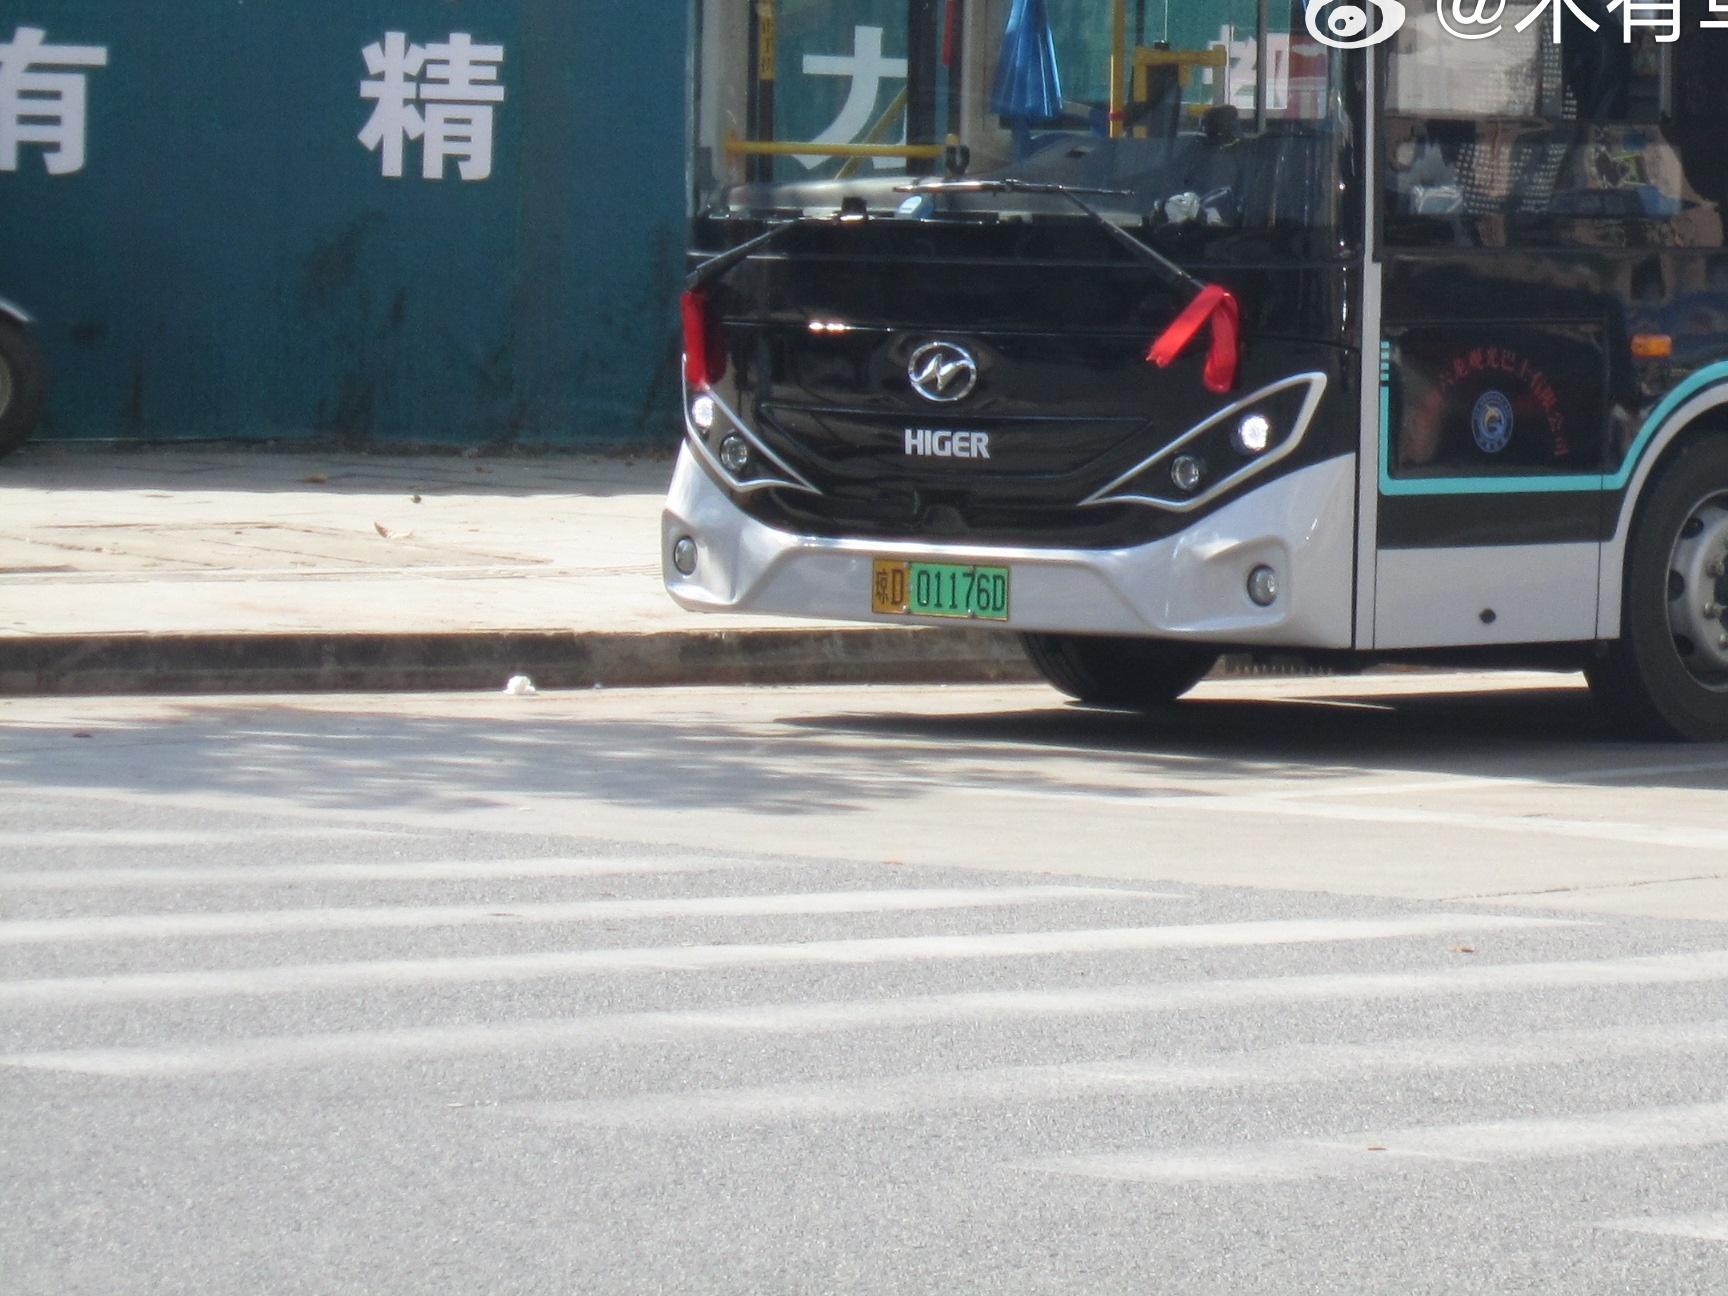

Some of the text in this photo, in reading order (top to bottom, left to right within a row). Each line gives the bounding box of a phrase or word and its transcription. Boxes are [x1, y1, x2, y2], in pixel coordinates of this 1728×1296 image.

[0, 27, 108, 176] 有
[358, 31, 506, 181] 精
[904, 428, 990, 459] HIGER
